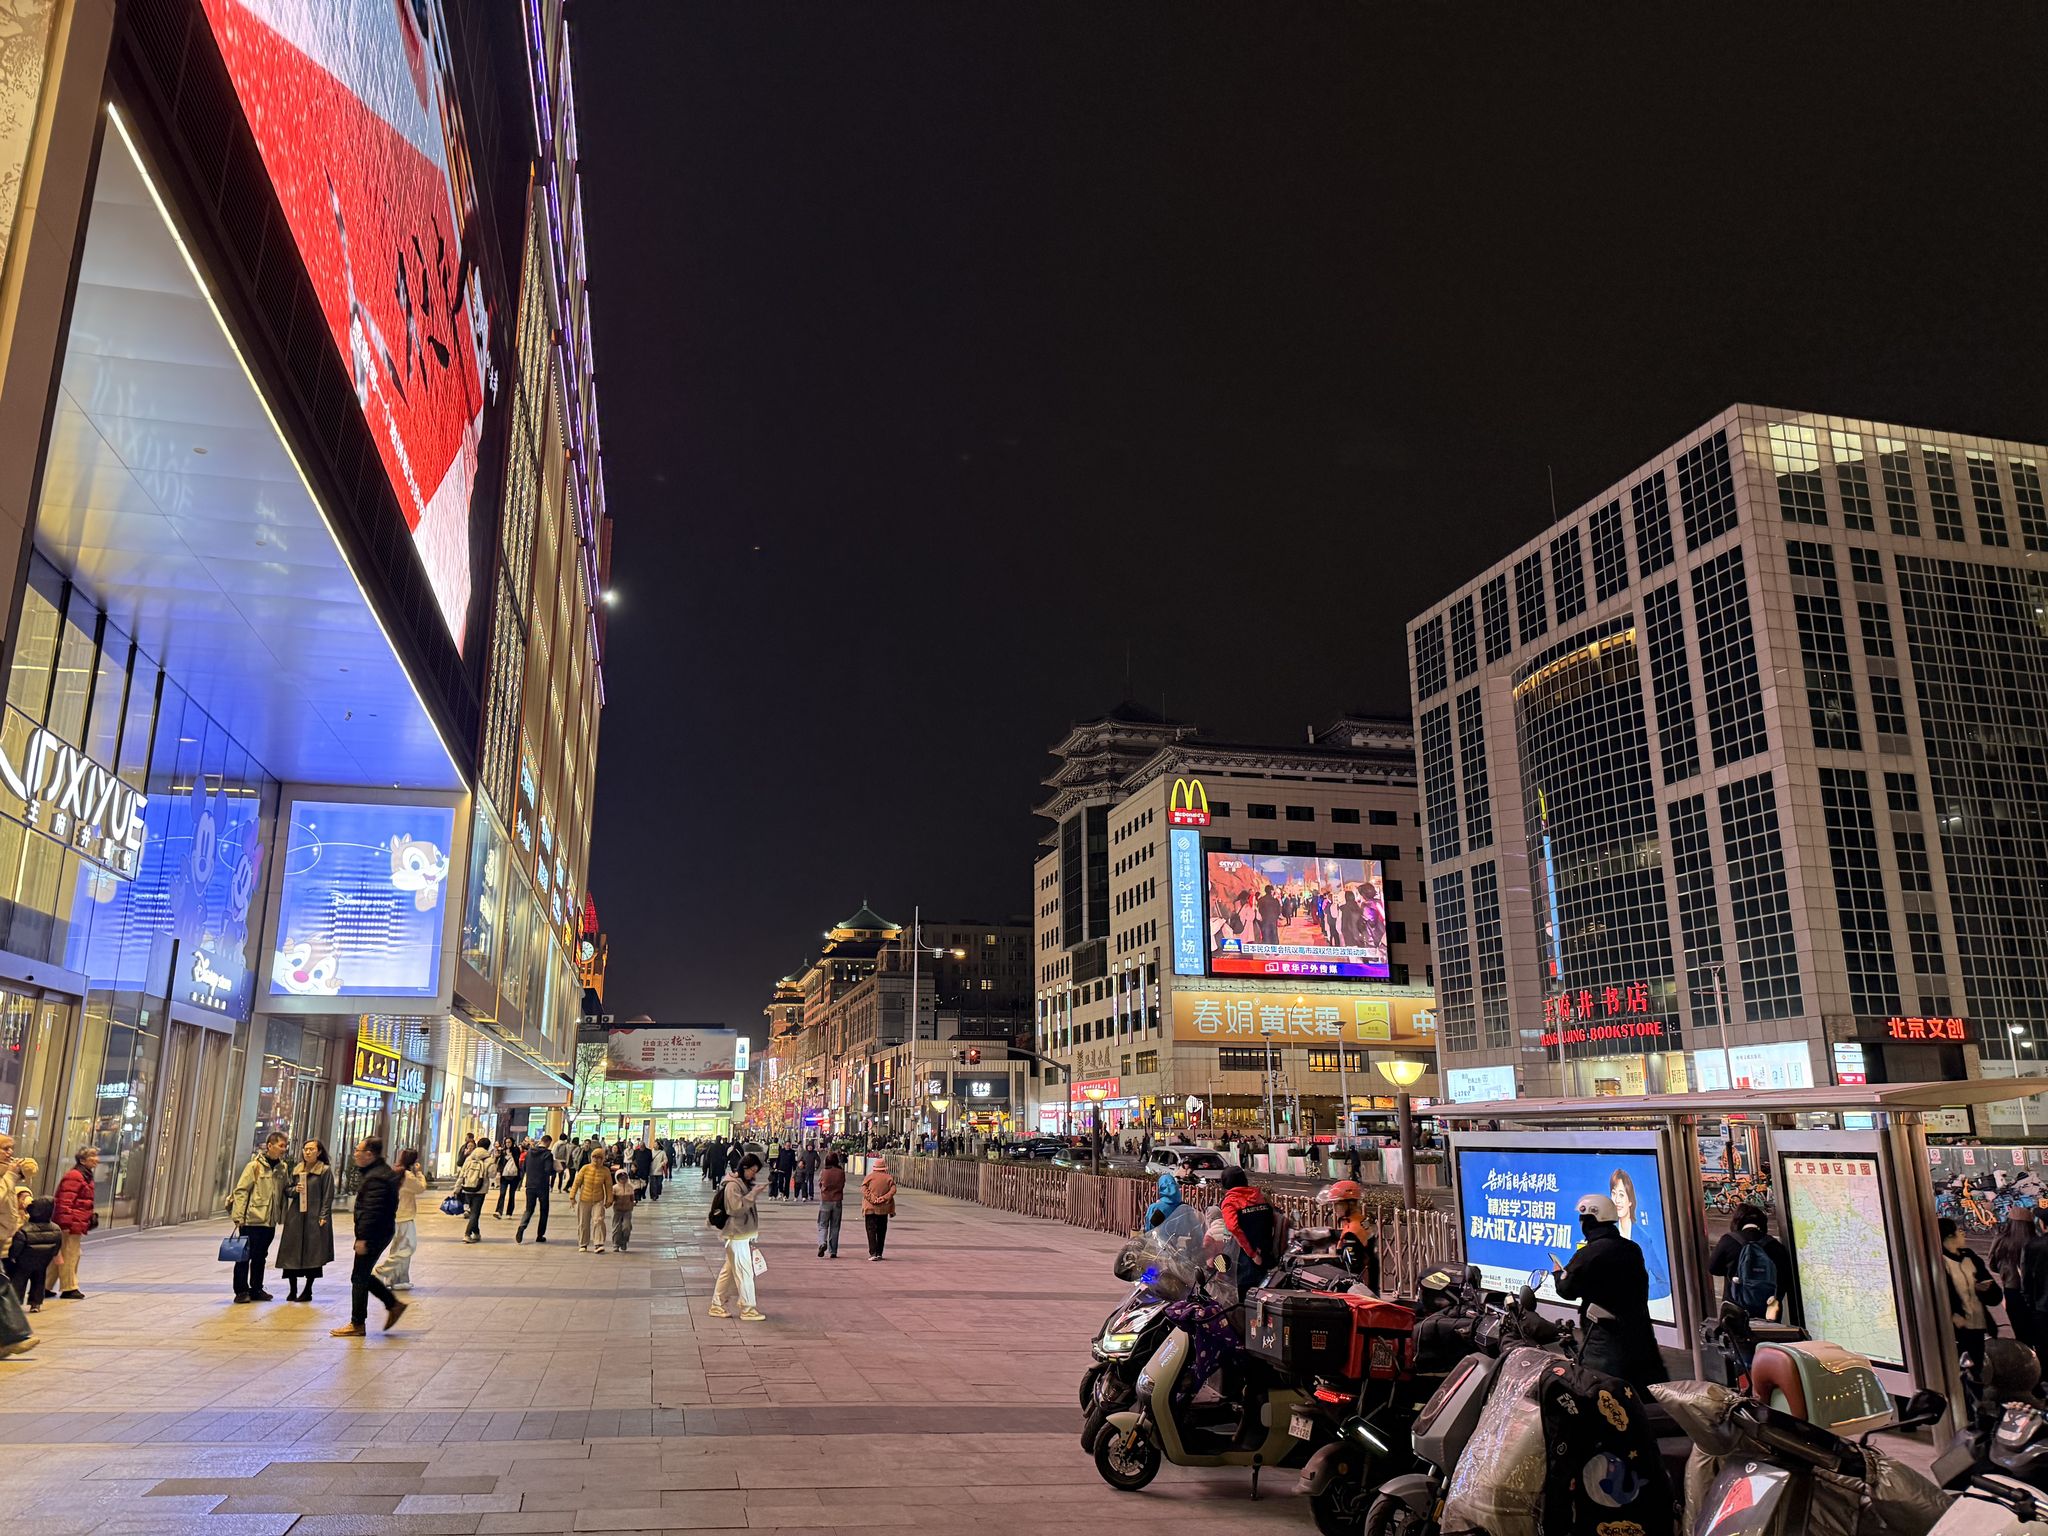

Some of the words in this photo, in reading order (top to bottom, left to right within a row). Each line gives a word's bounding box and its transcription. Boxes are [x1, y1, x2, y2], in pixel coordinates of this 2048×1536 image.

[1180, 893, 1195, 954] 手机广场
[1542, 981, 1648, 1023] 王府井书店
[1590, 1021, 1663, 1041] BOOKSTORE
[1887, 1017, 1965, 1039] 北京文创
[1487, 1197, 1556, 1220] 精准学习就用
[1470, 1215, 1572, 1249] 科大讯飞AI学习机
